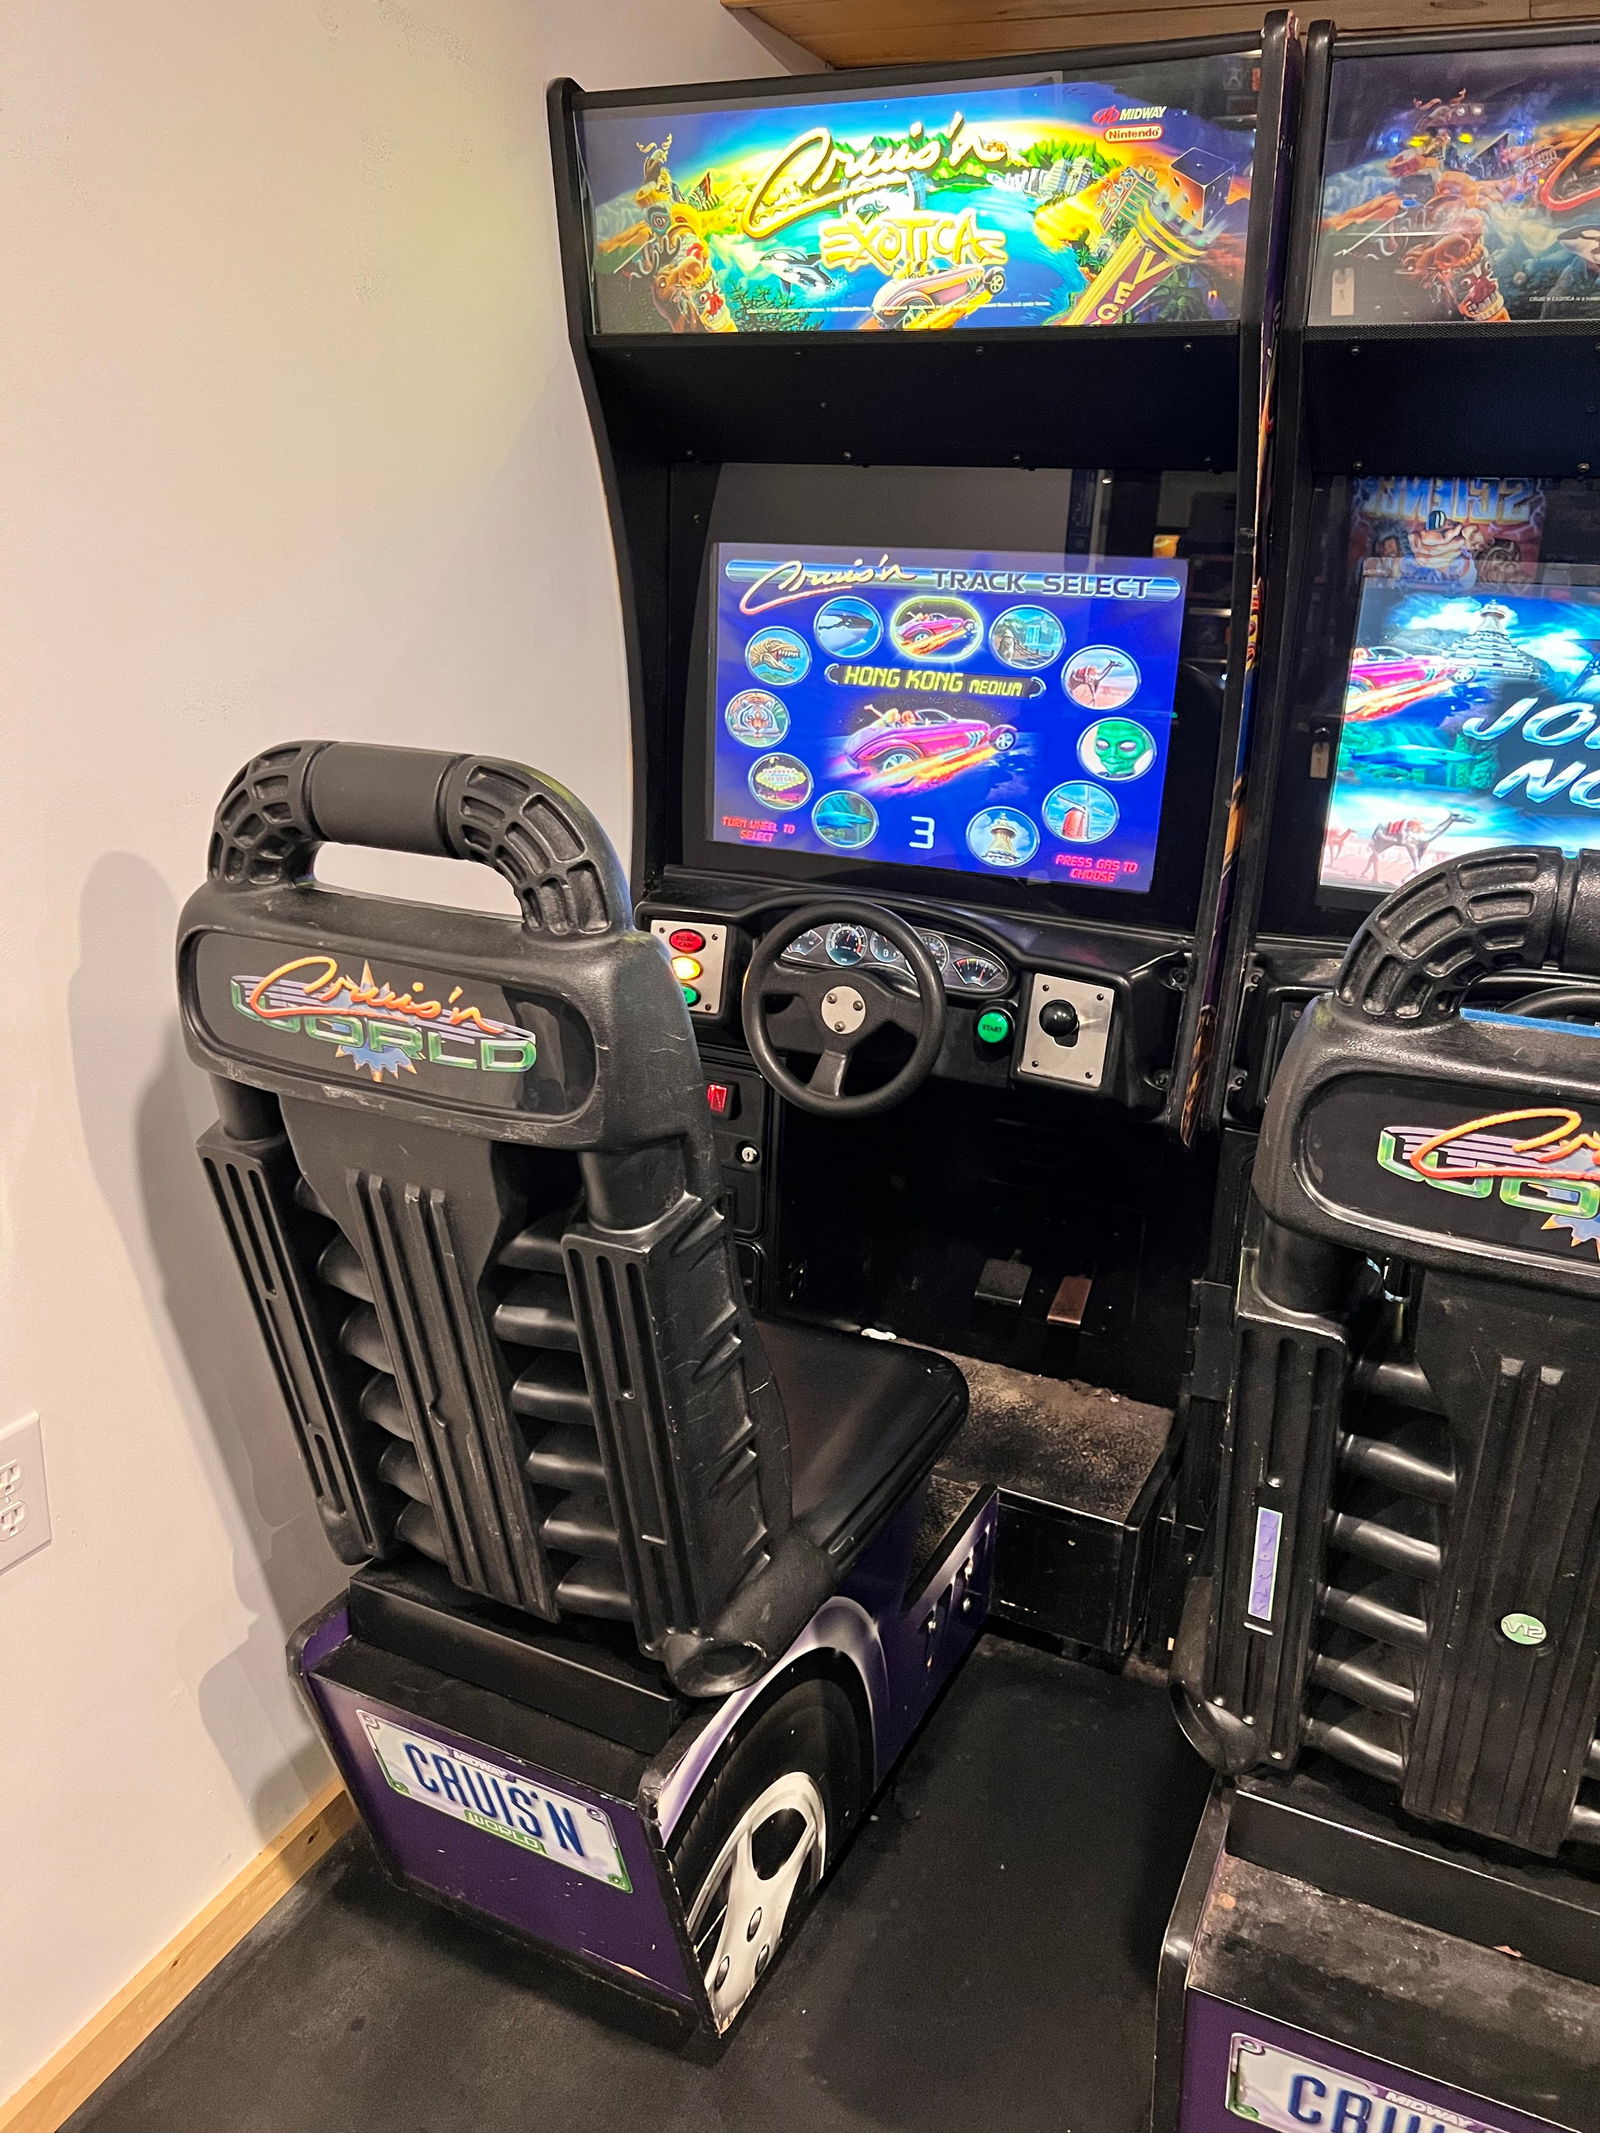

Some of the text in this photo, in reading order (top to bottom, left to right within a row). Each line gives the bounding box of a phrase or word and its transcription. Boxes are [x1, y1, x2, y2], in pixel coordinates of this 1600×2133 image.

[1119, 106, 1167, 121] MIDWAY
[1108, 128, 1160, 140] Nintendo
[821, 208, 1007, 275] EXOTICA
[1091, 248, 1173, 325] VEG
[739, 554, 1154, 615] Cruis'n TRACK SELECT
[844, 665, 1023, 697] HONG KONG MEDIUM
[1462, 697, 1600, 750] JO
[722, 816, 747, 828] TURN
[783, 823, 796, 834] TO
[740, 830, 774, 842] SELECT
[909, 815, 935, 850] 3
[1056, 854, 1138, 873] PRESS GAS TO
[1070, 868, 1116, 882] CHOOSE
[249, 955, 506, 1034] Cruis'n
[230, 979, 538, 1073] WORLD
[982, 1024, 1002, 1033] START
[403, 1743, 585, 1858] CRUIS'N
[467, 1811, 541, 1850] WORLD
[1385, 2091, 1475, 2128] MIDWAY
